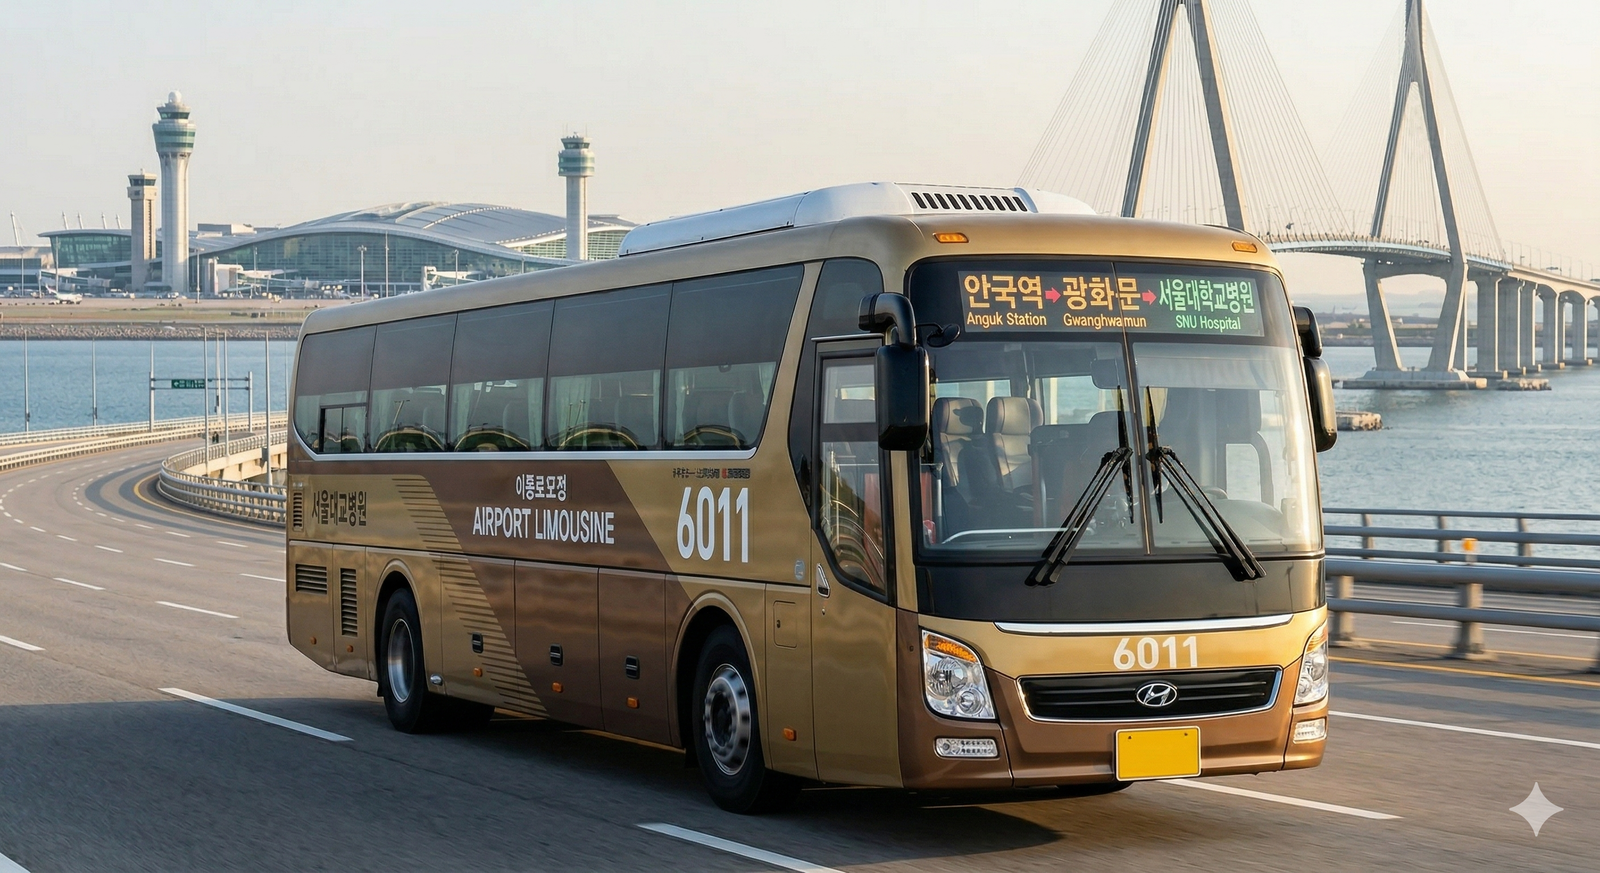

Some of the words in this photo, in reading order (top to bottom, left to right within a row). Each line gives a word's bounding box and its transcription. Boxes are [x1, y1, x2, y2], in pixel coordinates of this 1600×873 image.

[963, 274, 1044, 310] 안국역
[1062, 276, 1141, 311] 광화문
[1158, 278, 1255, 314] 서울대학교병원
[966, 311, 1003, 329] Anguk
[1006, 312, 1047, 326] Station
[1063, 313, 1147, 330] Gwanghwamun
[1175, 315, 1198, 329] SNU
[1200, 316, 1242, 333] Hospital
[472, 506, 532, 539] AIRPORT
[535, 508, 615, 545] LIMOUSINE
[676, 485, 749, 564] 6011
[1113, 636, 1198, 670] 6011
